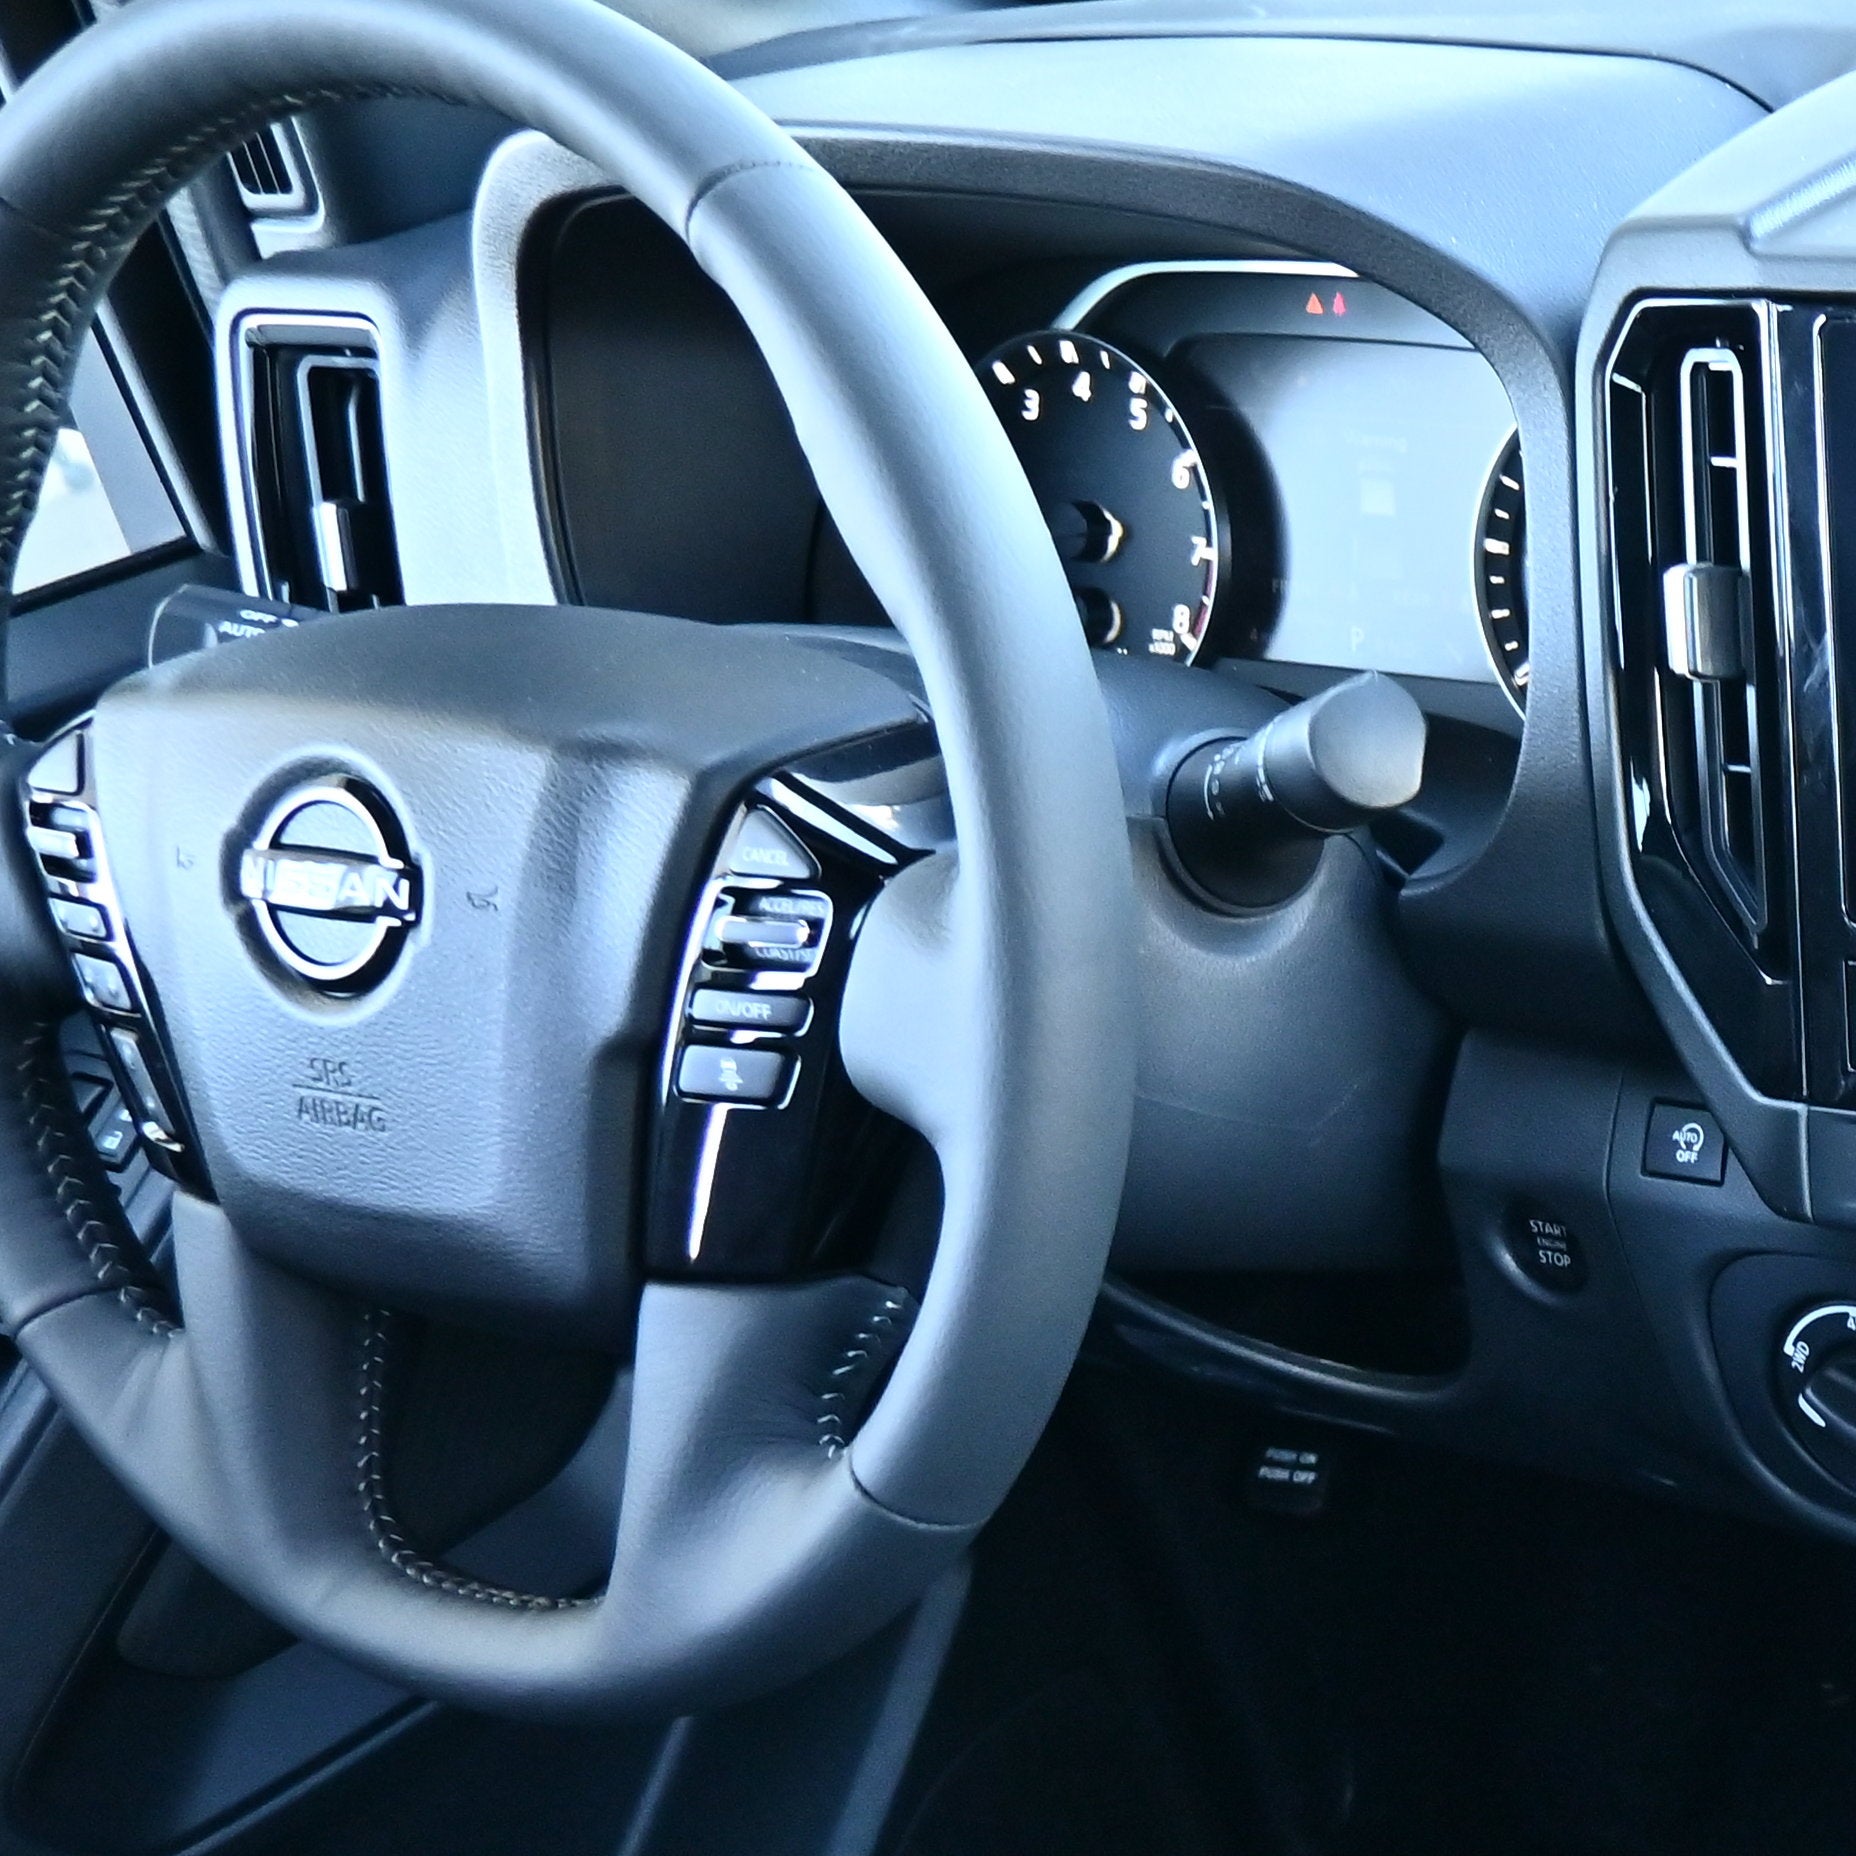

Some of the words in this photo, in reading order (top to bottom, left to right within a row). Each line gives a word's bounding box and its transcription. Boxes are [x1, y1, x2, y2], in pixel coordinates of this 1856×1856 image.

[1072, 371, 1091, 401] 4
[1021, 388, 1040, 421] 3
[1128, 397, 1147, 430] 5
[1171, 456, 1191, 489] 6
[1191, 536, 1208, 565] 7
[1172, 603, 1191, 634] 8
[297, 1096, 386, 1132] AIRBAG
[1675, 1149, 1698, 1164] OFF
[1529, 1219, 1567, 1237] START
[1538, 1251, 1571, 1268] STOP
[1791, 1341, 1811, 1374] 2WD
